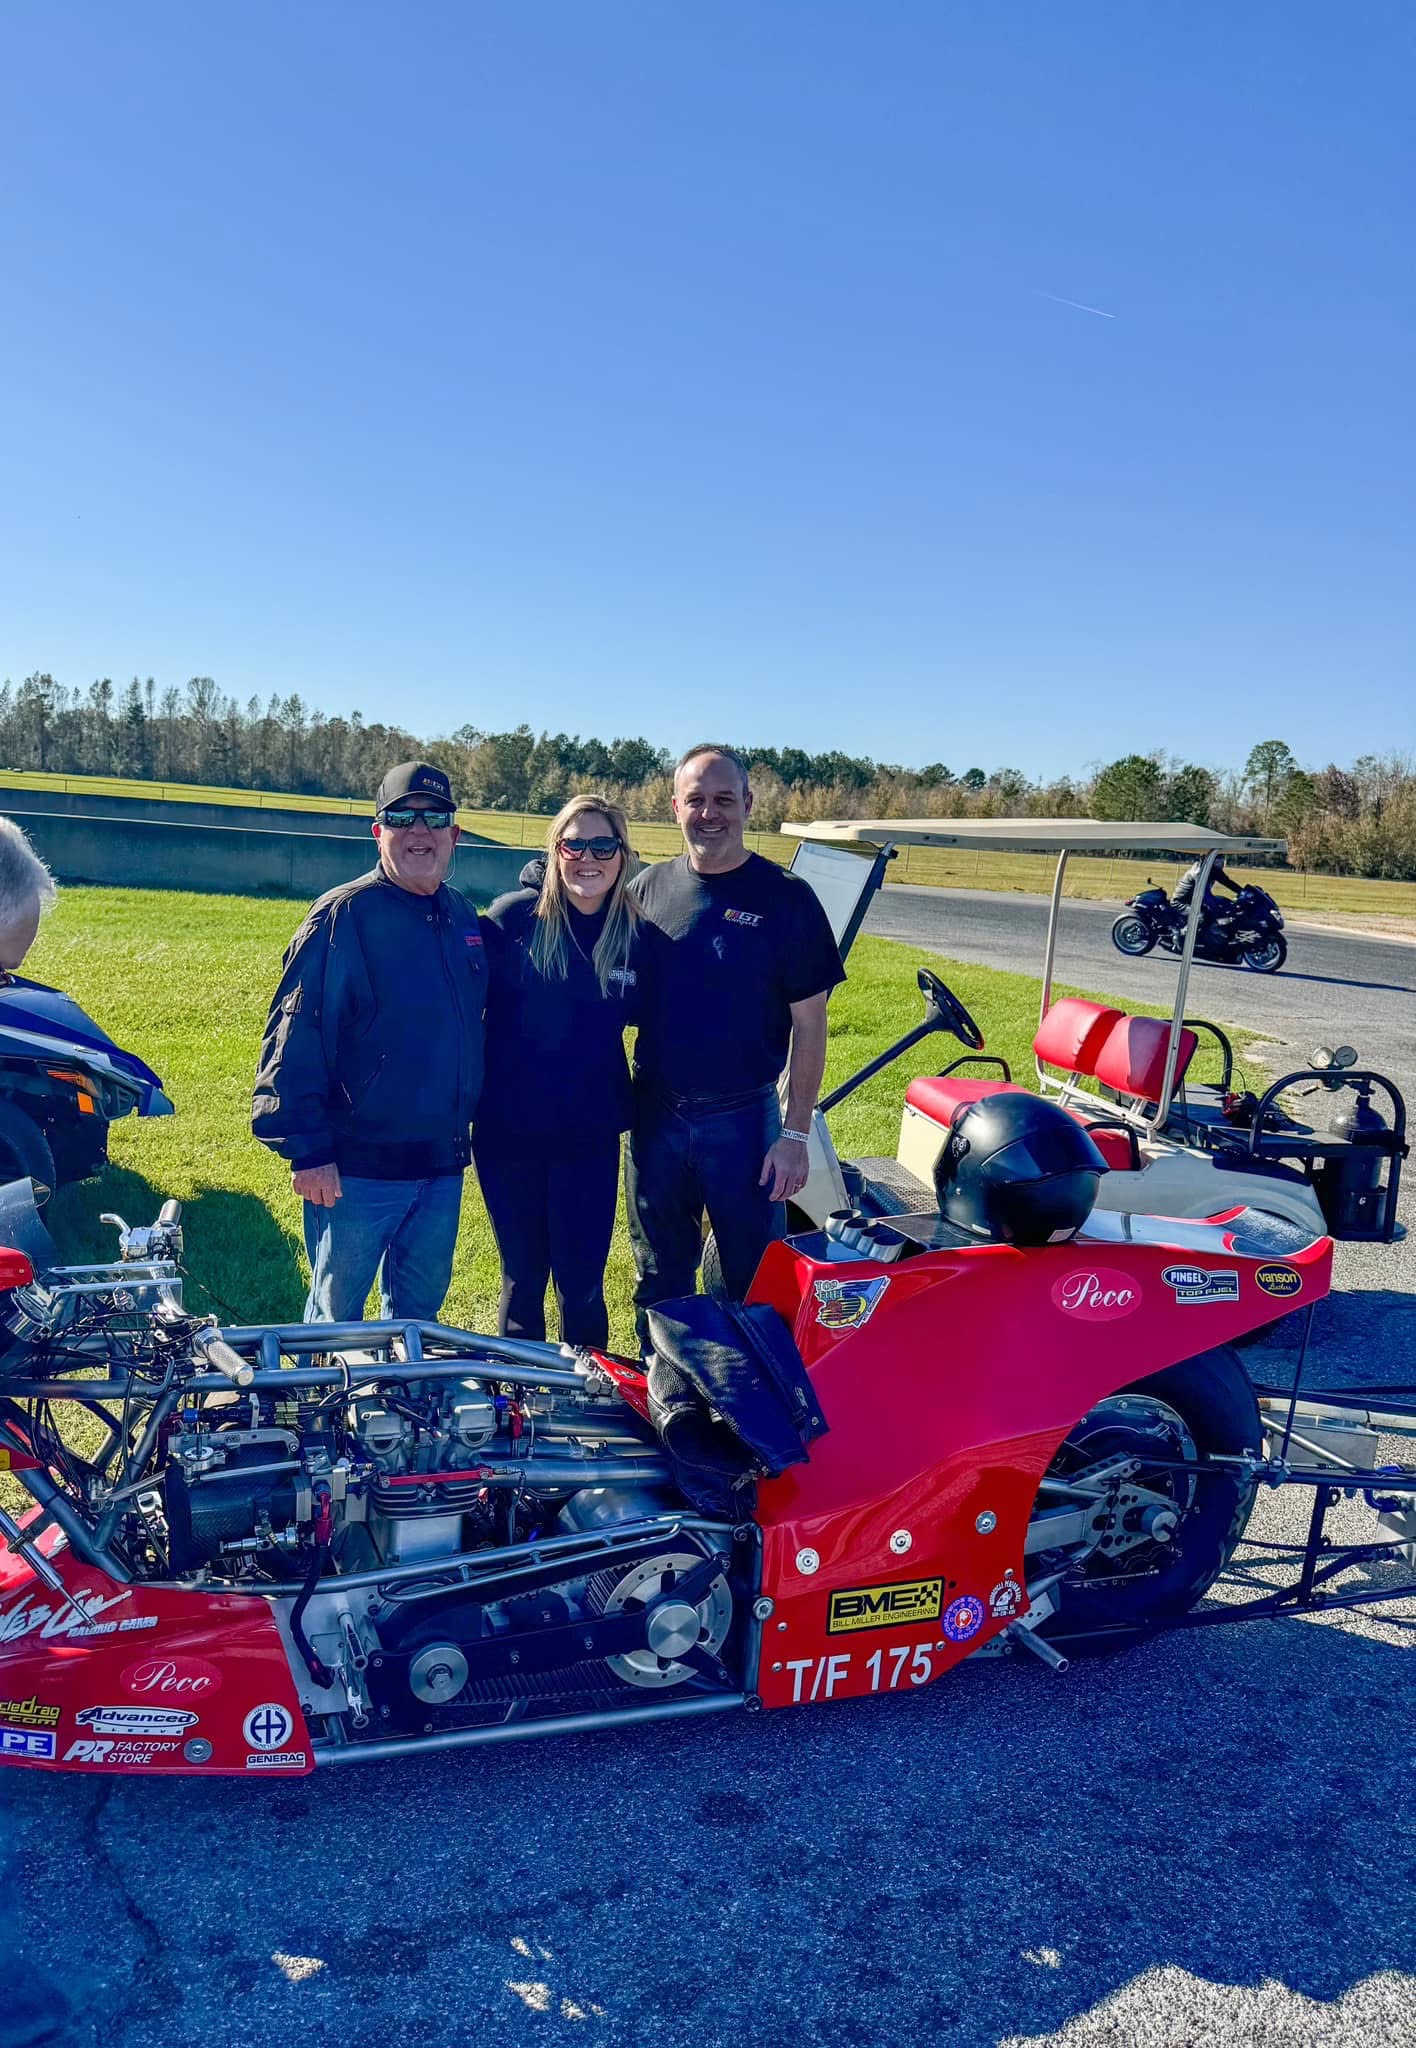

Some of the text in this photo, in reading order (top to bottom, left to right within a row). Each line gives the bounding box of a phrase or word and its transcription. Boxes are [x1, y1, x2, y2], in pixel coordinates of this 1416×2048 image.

[1170, 1271, 1203, 1283] PINGEL
[1062, 1273, 1134, 1310] Peco
[1179, 1286, 1237, 1297] TOP FUEL
[833, 1588, 919, 1618] BME
[832, 1607, 937, 1628] BILL MILLER ENGINEERING
[131, 1660, 213, 1693] Peco
[786, 1643, 933, 1702] T/F 175
[78, 1707, 192, 1723] Advanced
[62, 1740, 181, 1762] PR FACTORY
[108, 1752, 153, 1763] STORE
[248, 1753, 304, 1764] GENERAC
